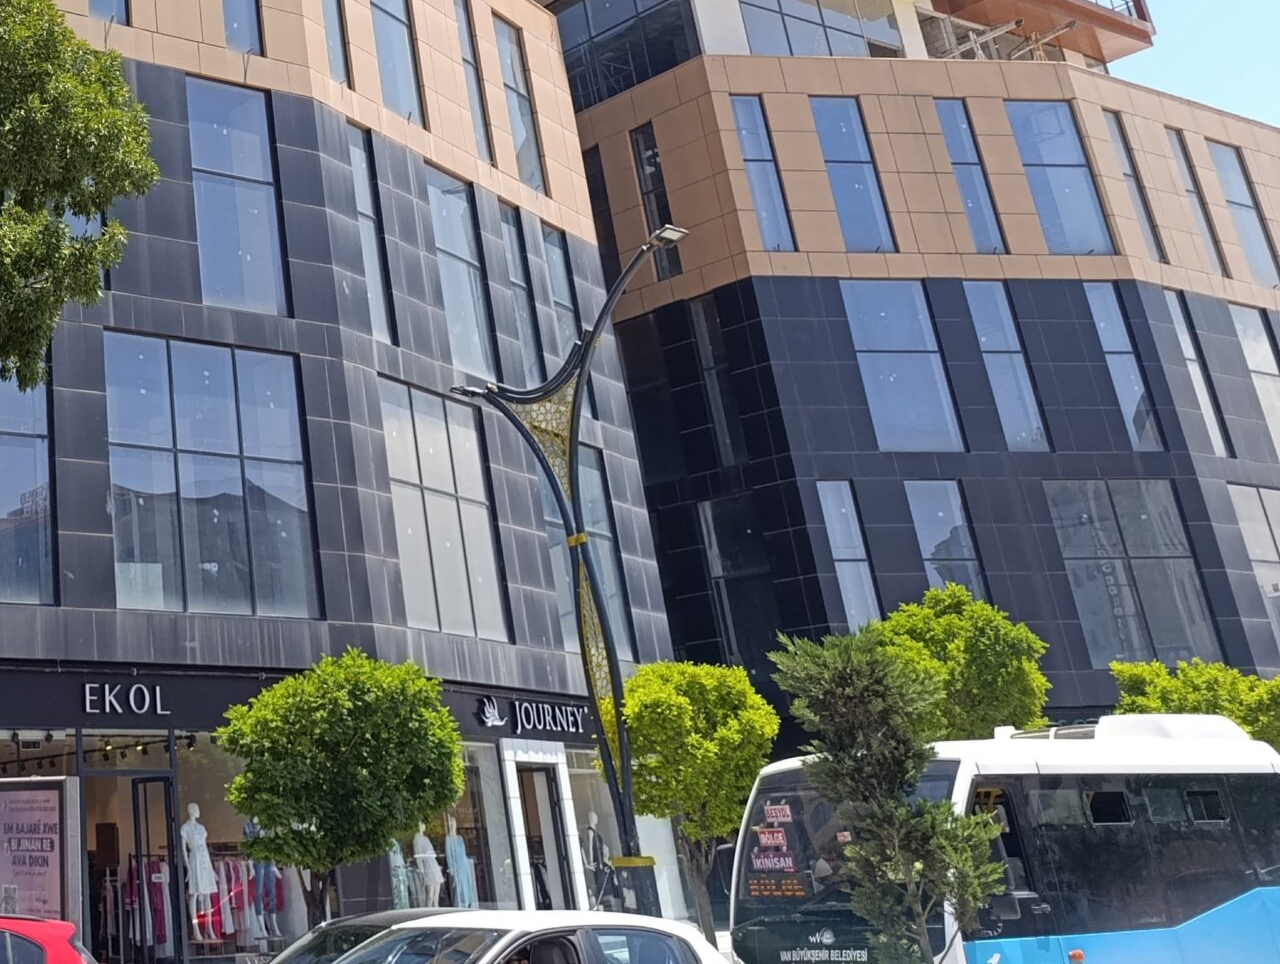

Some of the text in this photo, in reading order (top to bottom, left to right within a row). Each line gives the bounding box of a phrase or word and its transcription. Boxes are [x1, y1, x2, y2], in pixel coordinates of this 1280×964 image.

[85, 683, 171, 714] EKOL
[514, 700, 584, 735] JOURNEY
[760, 832, 785, 845] BÖLGE
[11, 855, 28, 867] AVA
[780, 947, 868, 963] VAN BÜYÜKŞEHİR BELEDİYESİ
